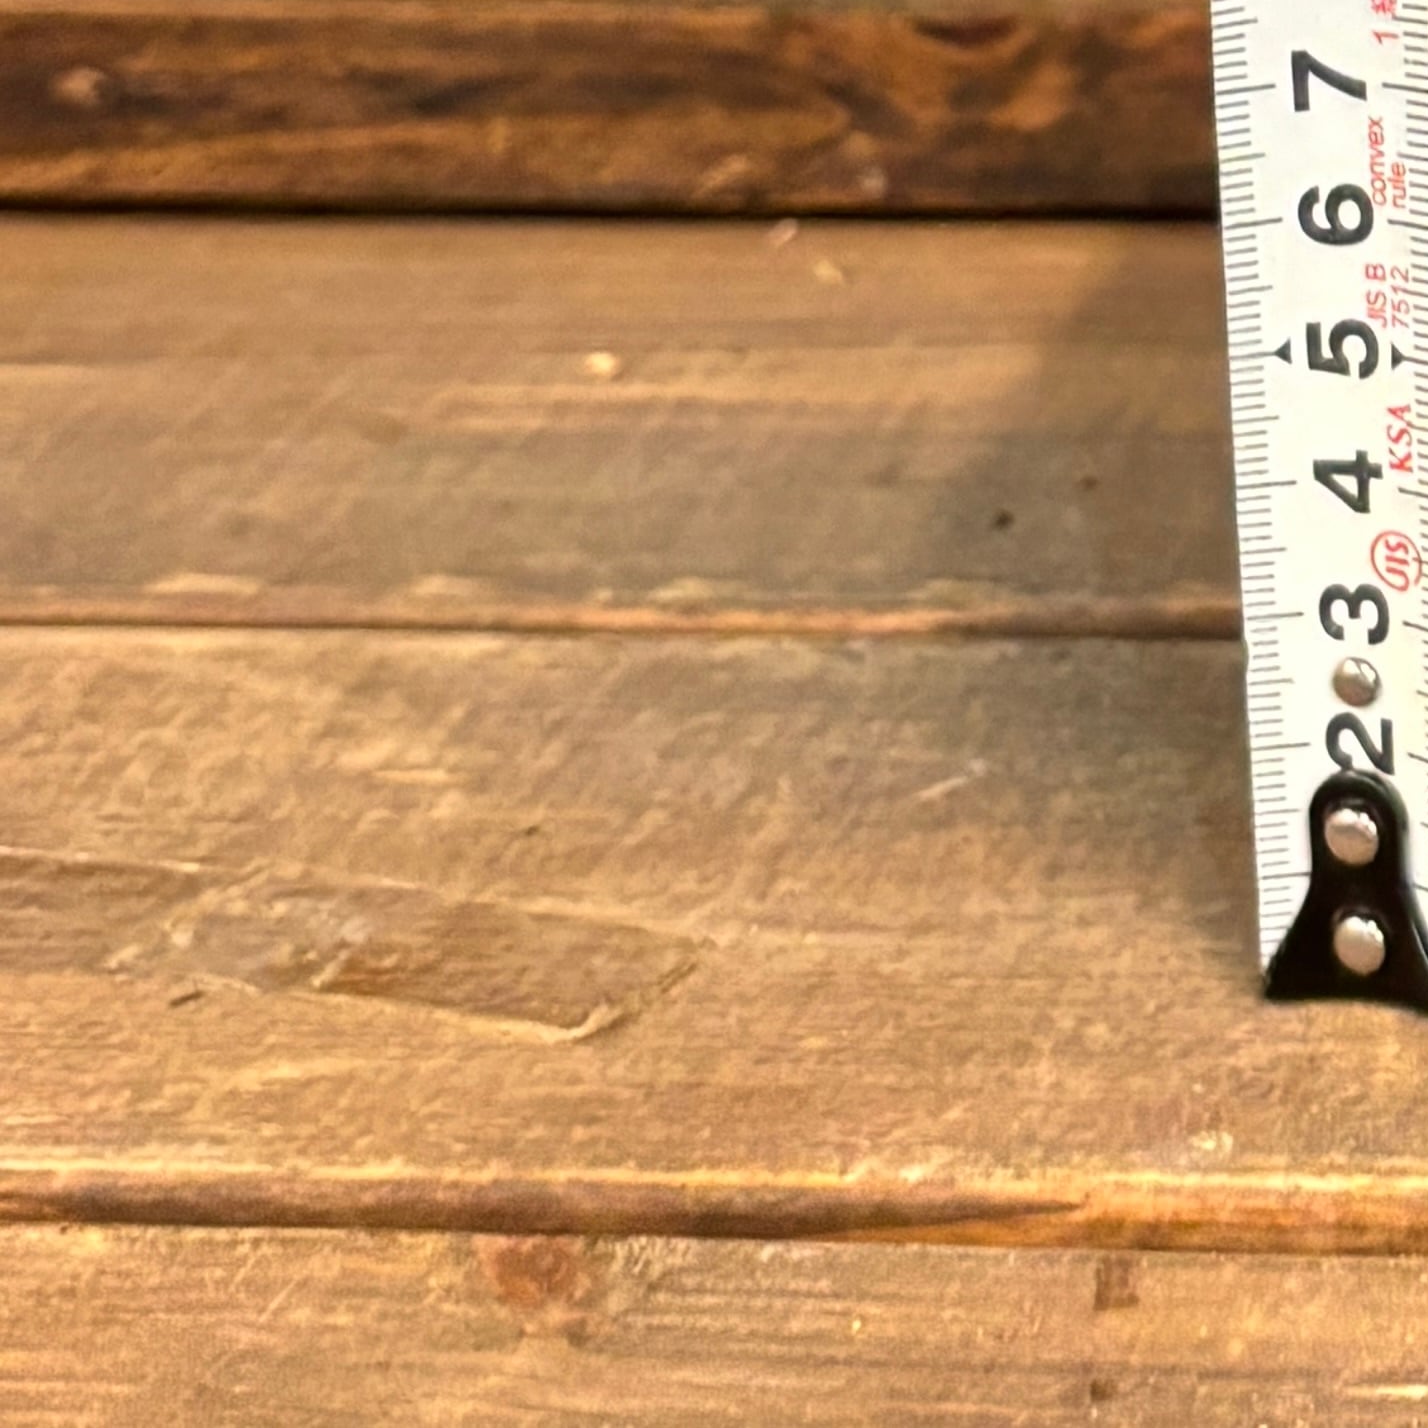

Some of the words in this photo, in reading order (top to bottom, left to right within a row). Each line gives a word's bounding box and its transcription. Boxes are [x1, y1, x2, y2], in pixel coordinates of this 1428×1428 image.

[1291, 50, 1367, 112] 7
[1368, 116, 1388, 207] convex
[1388, 162, 1407, 209] rule
[1298, 183, 1374, 246] 6
[1365, 263, 1387, 282] B
[1390, 267, 1410, 328] 7512
[1366, 292, 1388, 328] JIS
[1306, 319, 1379, 379] 5
[1387, 403, 1413, 473] KSA
[1313, 449, 1383, 514] 4
[1319, 583, 1390, 645] 3
[1325, 712, 1395, 775] 2
